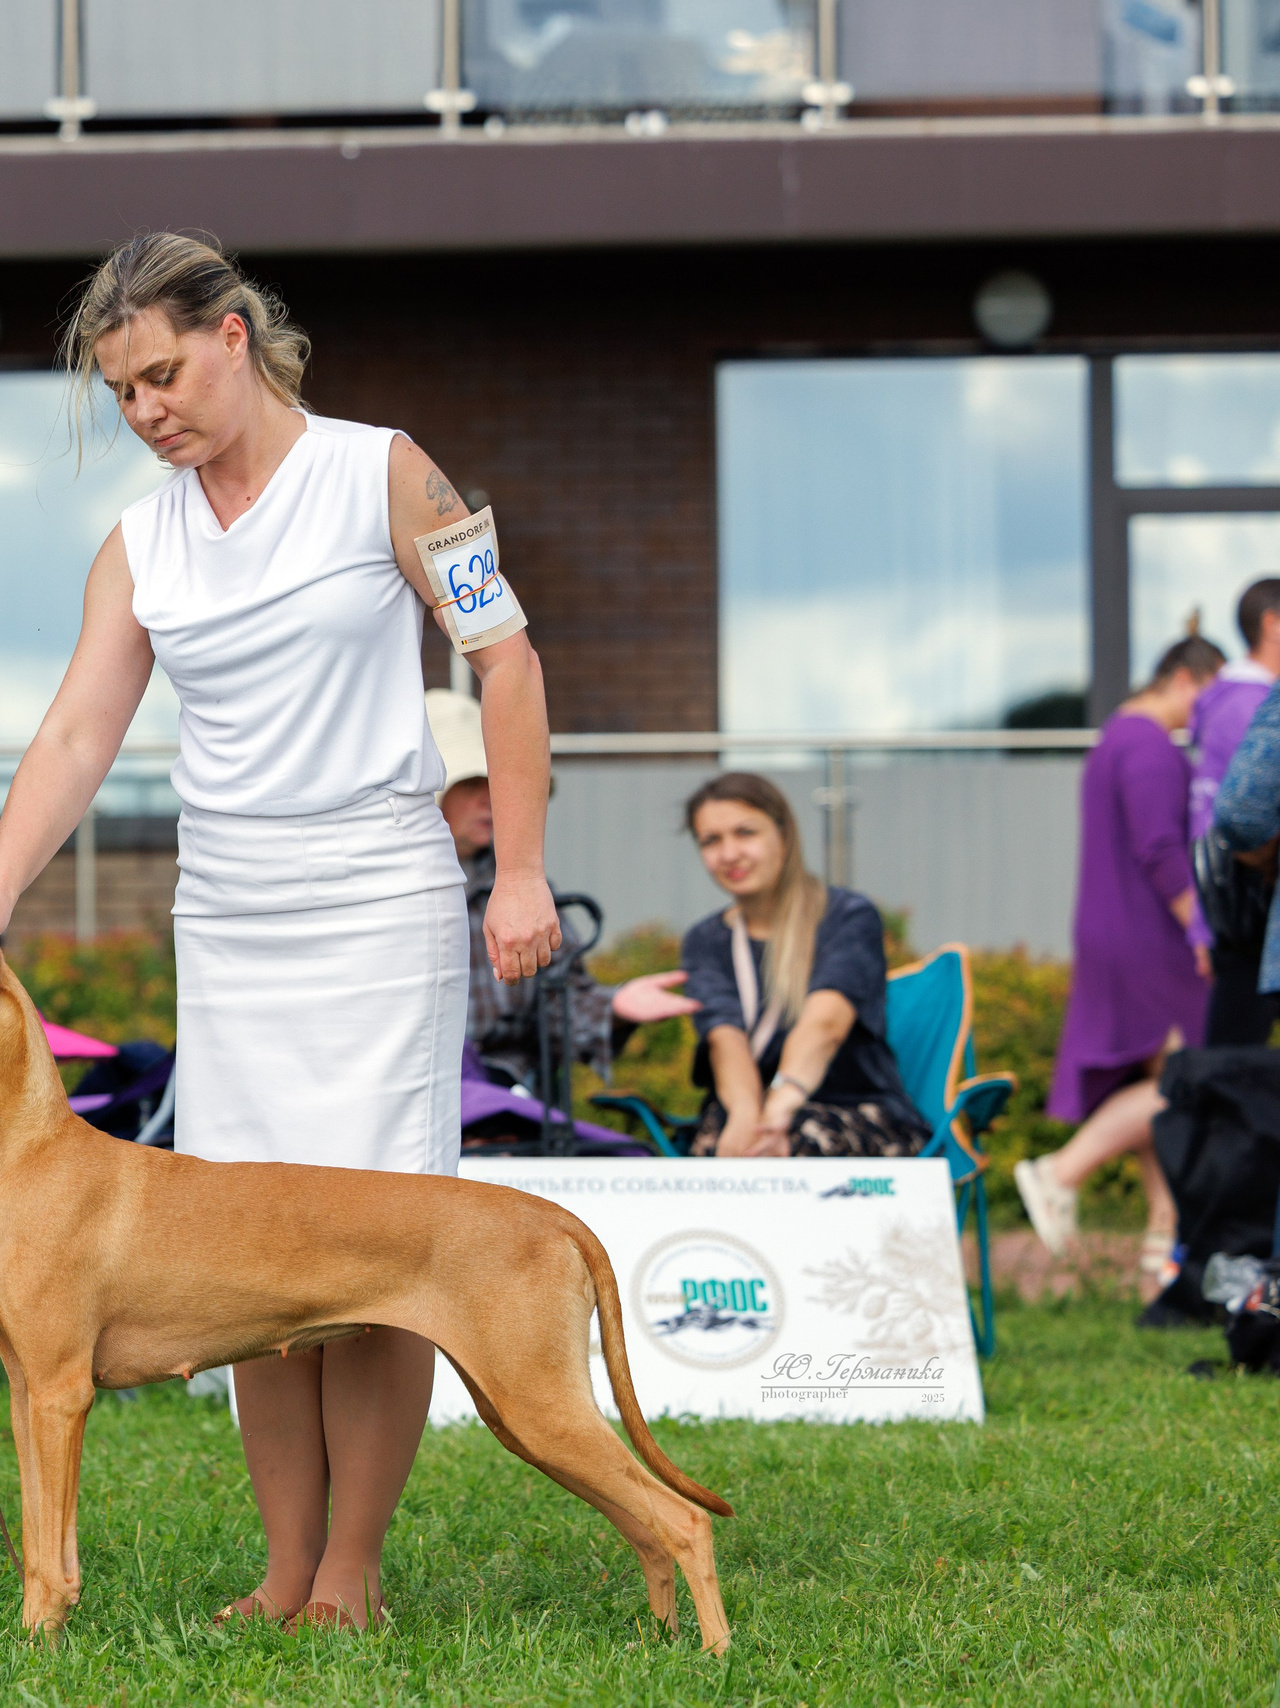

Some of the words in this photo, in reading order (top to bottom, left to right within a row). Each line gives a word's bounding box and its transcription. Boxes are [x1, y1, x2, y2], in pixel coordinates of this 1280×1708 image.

[427, 522, 484, 552] GRANDORF
[448, 548, 503, 614] 629
[609, 1176, 811, 1195] СОБАКОВОДСТВА
[681, 1278, 768, 1313] РФОС
